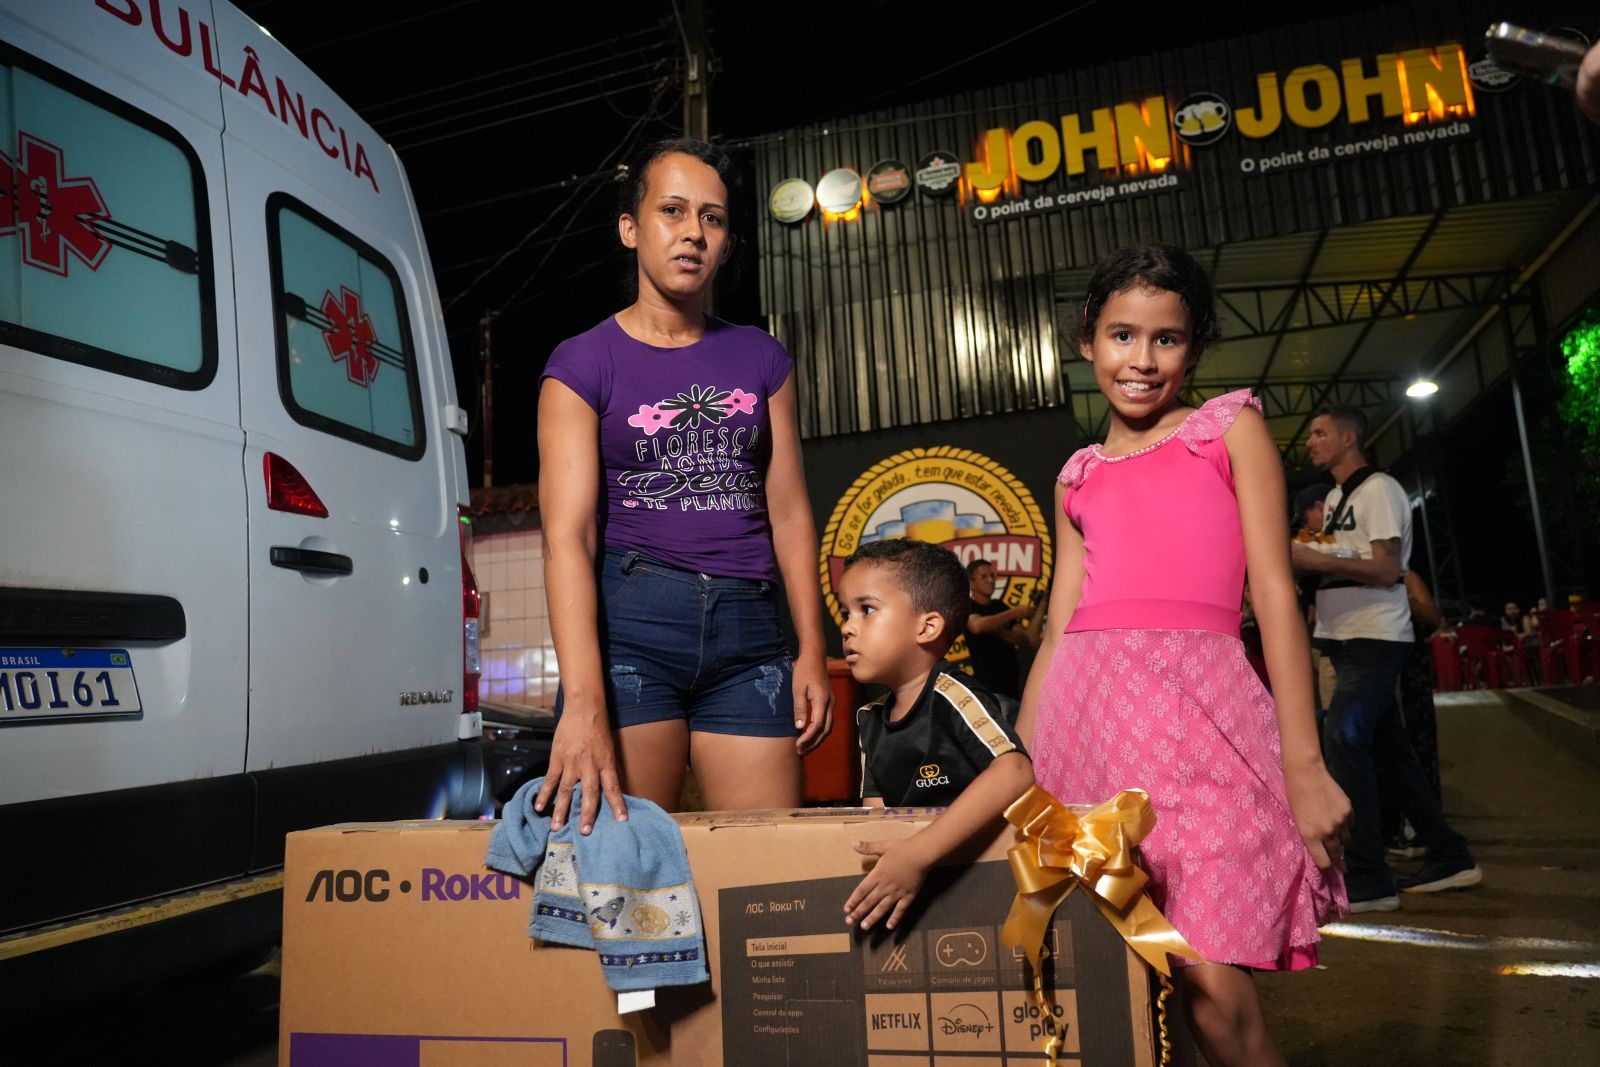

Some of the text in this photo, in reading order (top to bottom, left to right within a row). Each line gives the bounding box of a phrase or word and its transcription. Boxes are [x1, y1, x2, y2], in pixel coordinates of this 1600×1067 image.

[1235, 44, 1468, 138] JOHN
[966, 96, 1171, 189] JOHN
[1240, 121, 1470, 173] O point da cerveja nevada
[974, 172, 1178, 220] O point da cerveja nevada
[617, 469, 758, 498] Deus
[643, 499, 668, 510] TE
[848, 514, 862, 530] se
[856, 496, 873, 516] for
[915, 465, 941, 478] tem
[943, 466, 964, 480] que
[965, 473, 992, 491] estar
[990, 490, 1027, 529] nevada!
[2, 656, 41, 665] BRASIL
[400, 690, 453, 706] RENAULT
[916, 775, 950, 788] GUCCI
[305, 869, 390, 902] AOC
[745, 902, 764, 914] AOC
[793, 899, 806, 911] TV
[751, 942, 787, 952] Tela inicial
[751, 959, 795, 969] O que assistir
[752, 976, 785, 984] Minha lista
[752, 992, 783, 1002] Pesquisar
[1013, 1001, 1064, 1023] gloo
[871, 1013, 921, 1031] NETFLIX
